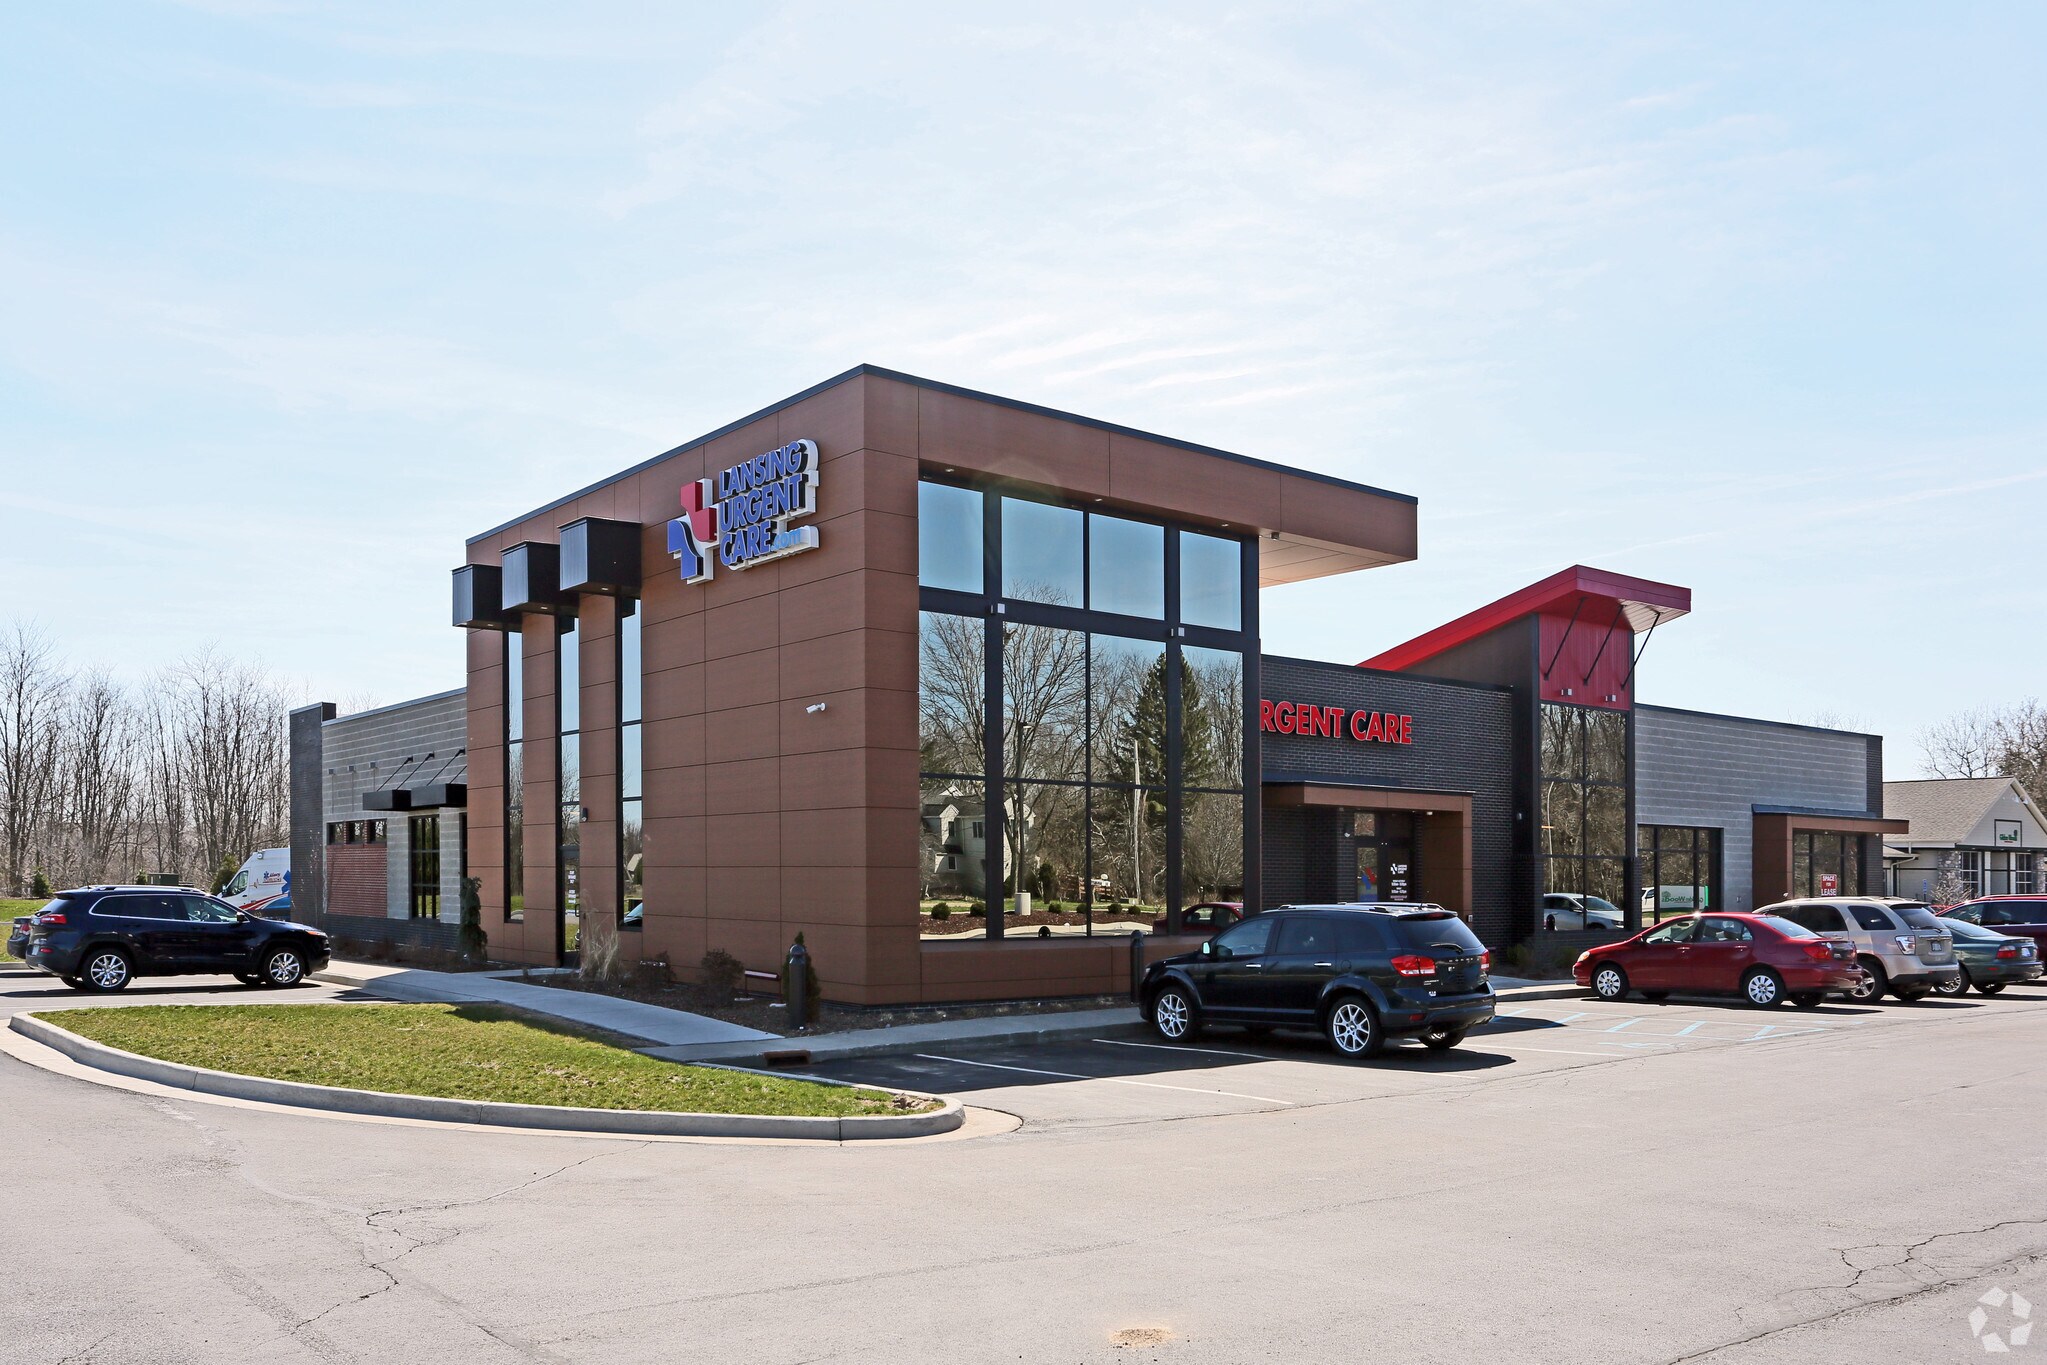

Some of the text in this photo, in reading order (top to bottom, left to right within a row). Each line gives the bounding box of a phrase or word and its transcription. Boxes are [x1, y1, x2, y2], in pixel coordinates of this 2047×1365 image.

[719, 441, 801, 499] LANSING
[719, 473, 803, 532] URGENT
[1260, 699, 1413, 744] RGENT CARE
[1821, 888, 1836, 896] LEASE
